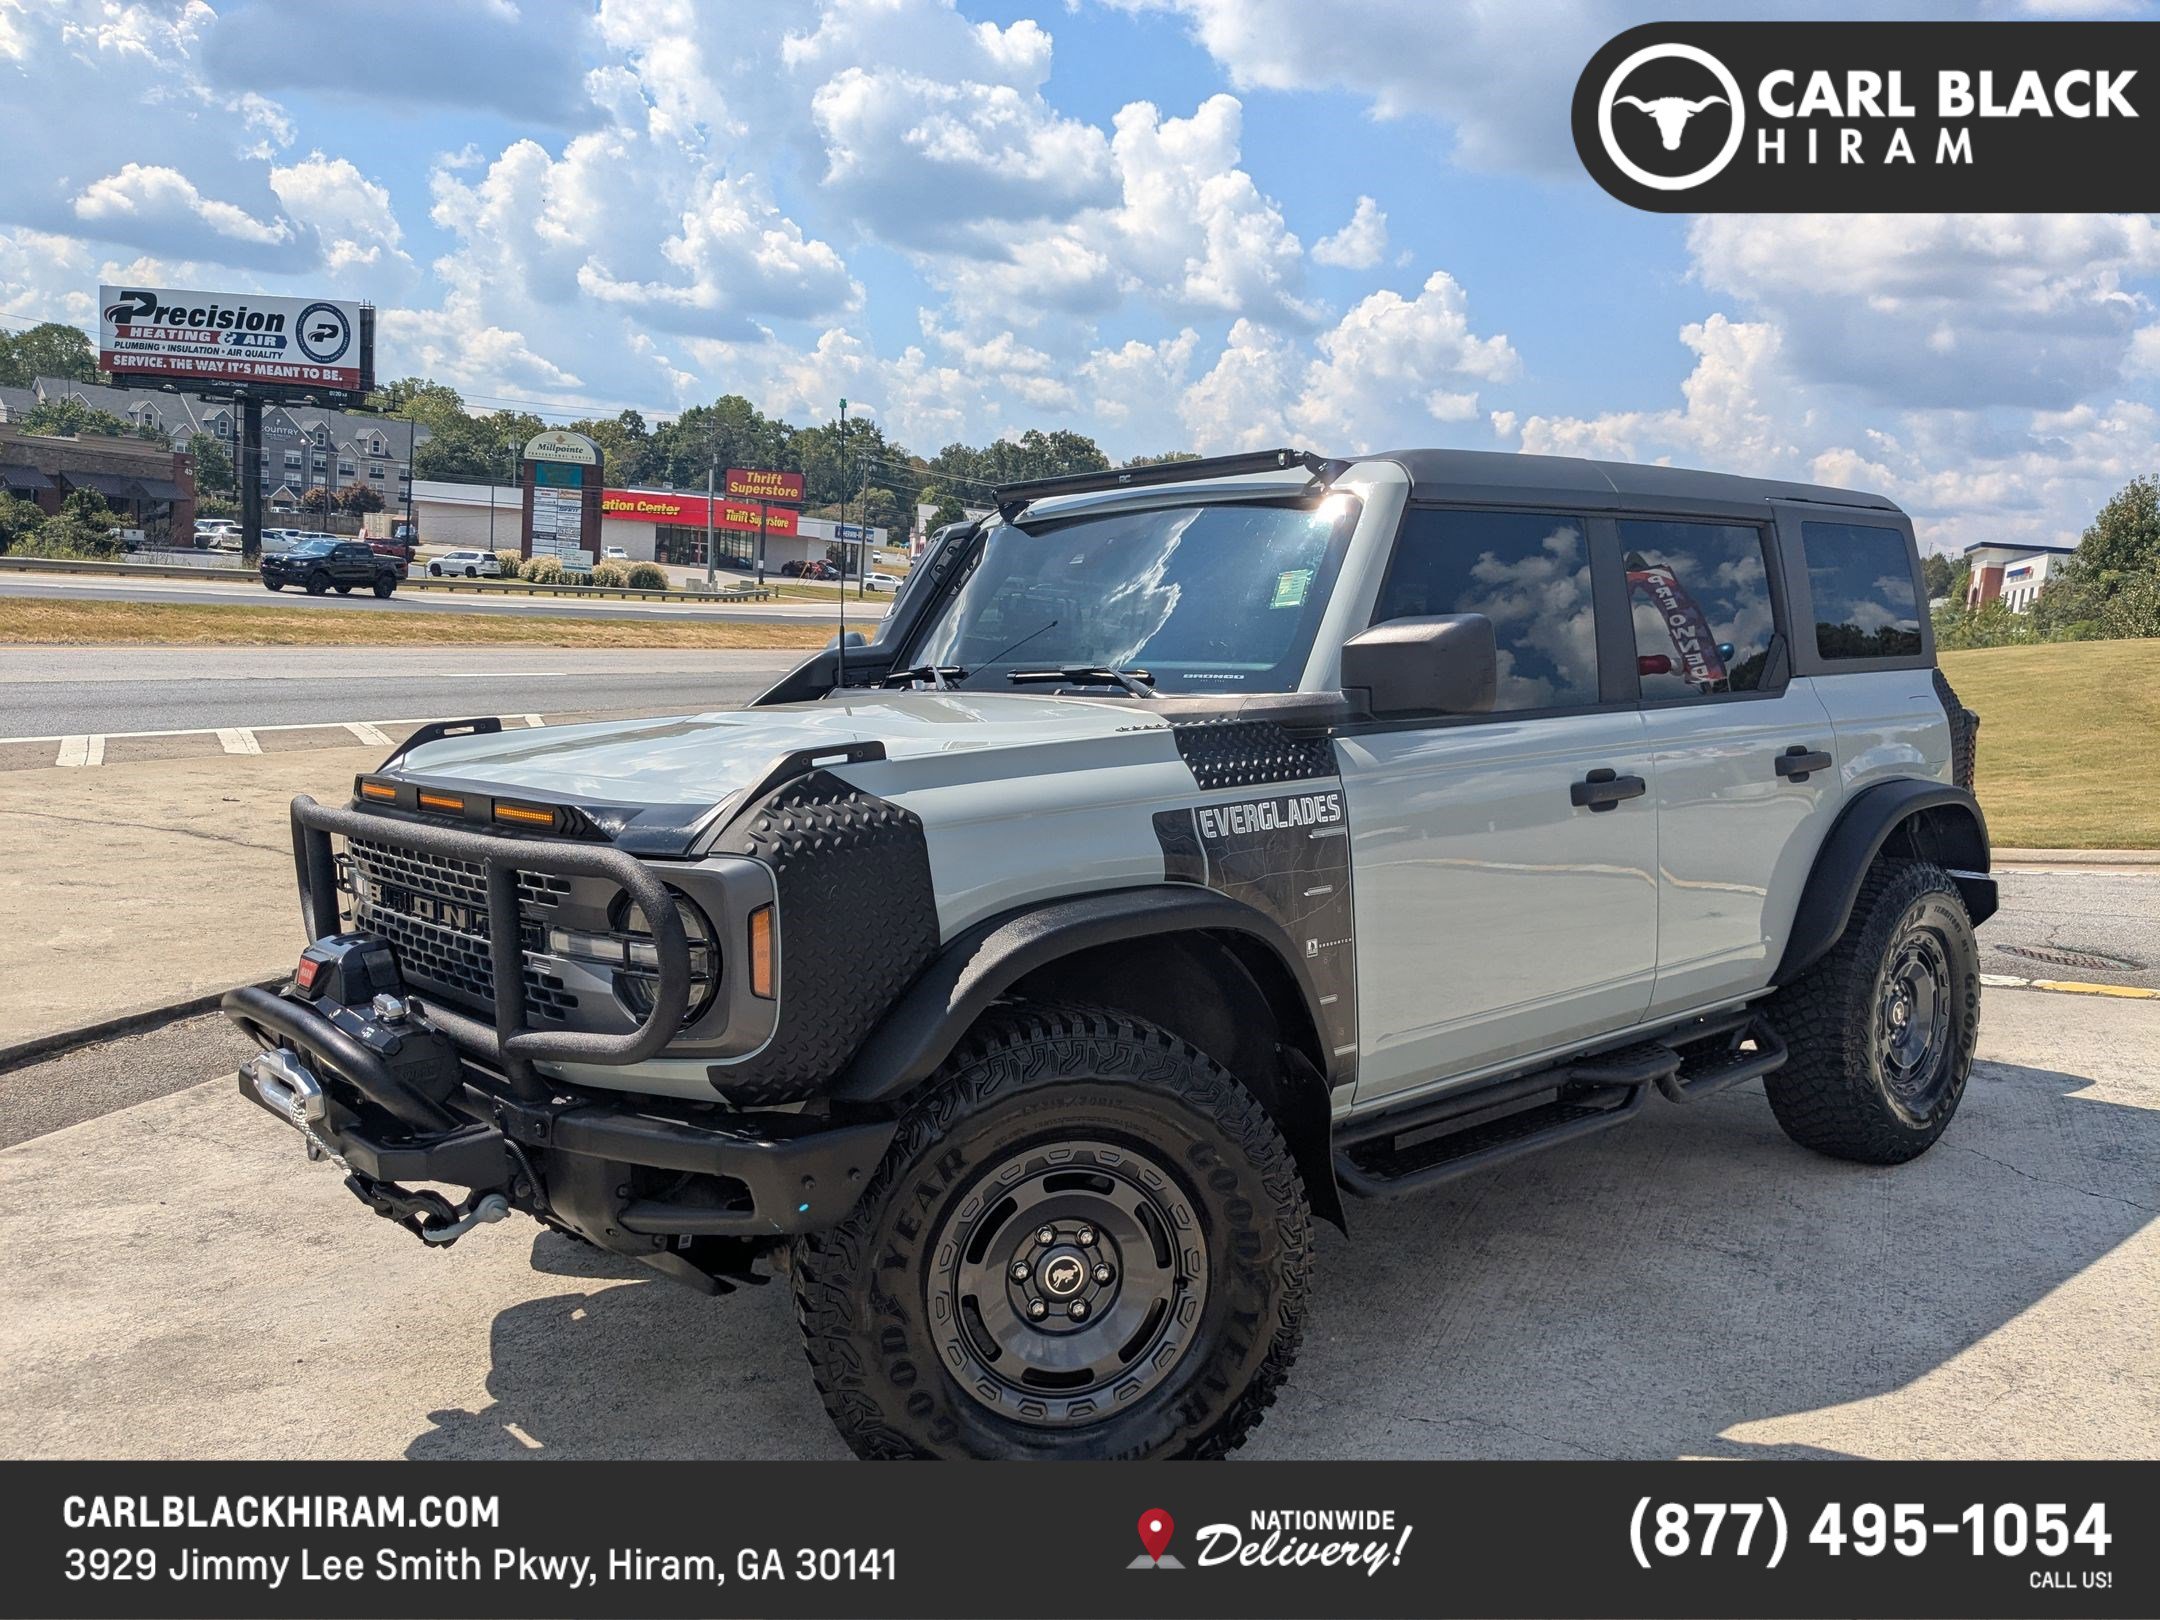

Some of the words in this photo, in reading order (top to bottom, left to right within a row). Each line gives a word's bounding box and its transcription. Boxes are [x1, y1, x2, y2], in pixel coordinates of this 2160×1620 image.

[105, 291, 286, 333] Precision
[129, 327, 212, 342] HEATING
[224, 332, 237, 345] &
[244, 335, 277, 347] AIR
[114, 341, 160, 351] PLUMBING
[167, 344, 224, 355] INSULATION
[227, 348, 242, 357] AIR
[244, 350, 284, 360] QUALITY
[113, 354, 167, 368] SERVICE.
[169, 358, 193, 370] THE
[195, 359, 224, 372] WAY
[228, 362, 252, 374] IT'S
[254, 364, 300, 378] MEANT
[302, 368, 320, 379] TO
[322, 370, 343, 381] BE.
[537, 443, 584, 454] Millpointe
[747, 471, 782, 485] Thrift
[730, 482, 799, 498] Superstore
[637, 501, 680, 515] Center
[726, 509, 748, 523] Thrift
[749, 512, 789, 528] Suprstore
[1199, 793, 1342, 839] EVERGLADES
[882, 1147, 969, 1272] YEAR
